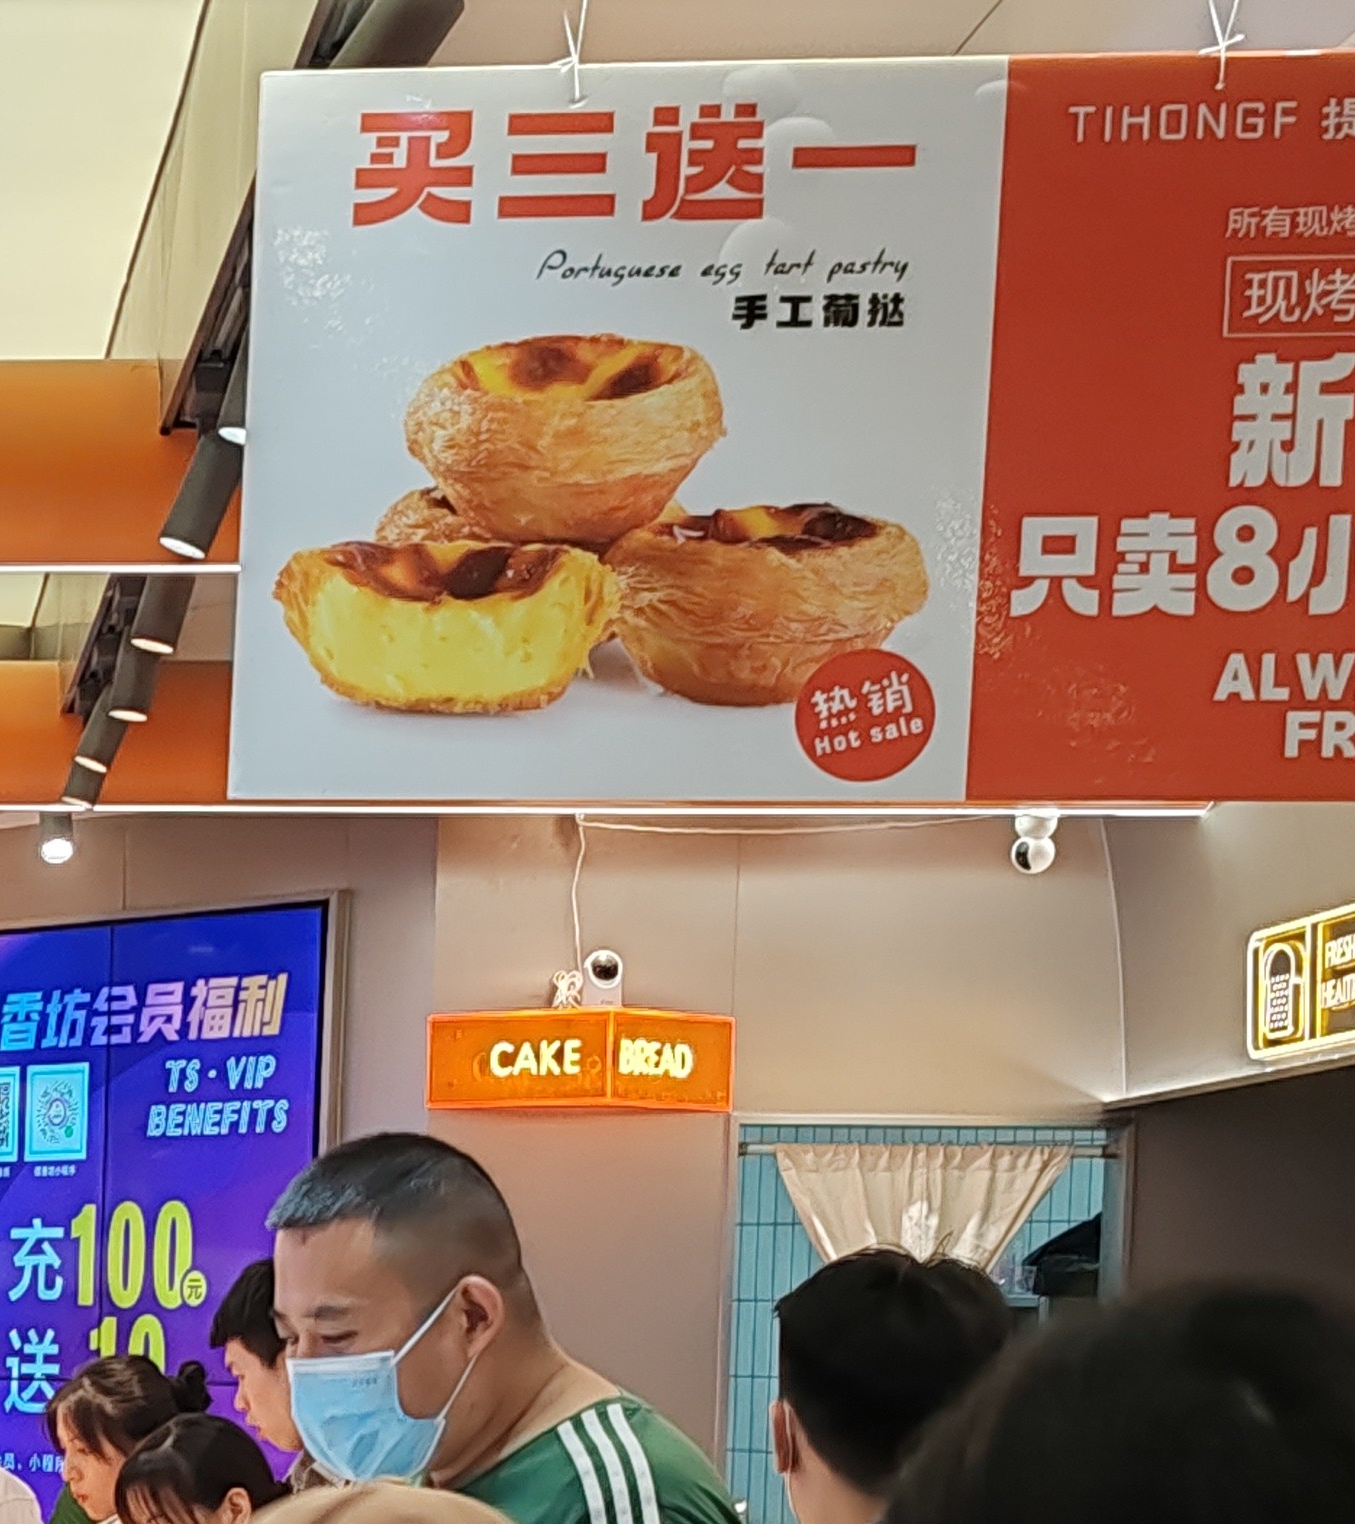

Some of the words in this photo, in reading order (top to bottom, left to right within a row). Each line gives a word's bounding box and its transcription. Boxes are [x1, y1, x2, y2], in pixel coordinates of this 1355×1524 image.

[1067, 100, 1299, 144] TIHONGF
[352, 102, 918, 228] 买三送一
[535, 248, 682, 287] Portuguese
[699, 257, 743, 287] egg
[763, 248, 815, 277] tart
[826, 247, 910, 283] pastry
[810, 669, 915, 731] 热销
[814, 730, 862, 758] Hot
[869, 715, 925, 747] sale
[489, 1038, 583, 1079] CAKE
[618, 1037, 694, 1080] BREAD
[146, 1098, 290, 1138] BENEFITS
